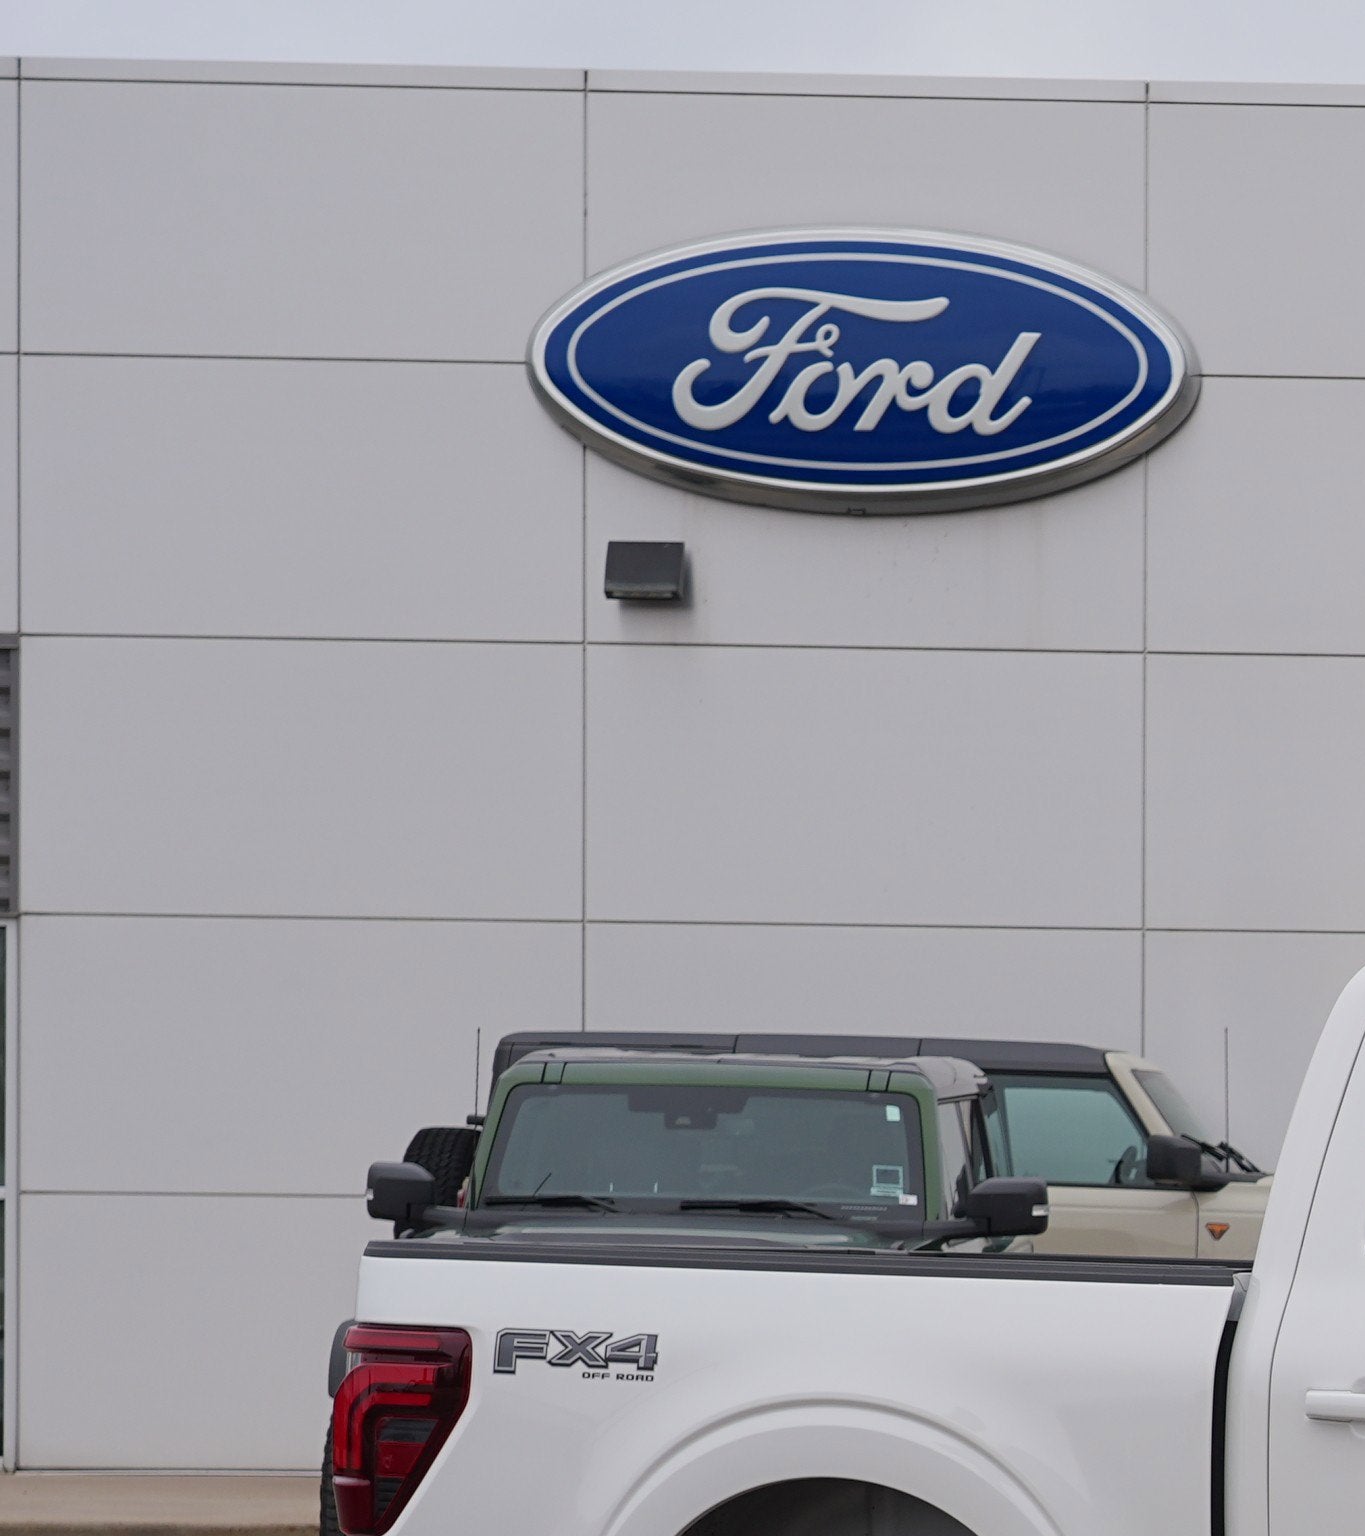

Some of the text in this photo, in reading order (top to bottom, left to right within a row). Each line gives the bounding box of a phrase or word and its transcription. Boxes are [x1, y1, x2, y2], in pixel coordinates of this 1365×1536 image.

[672, 286, 1042, 437] Ford
[493, 1327, 659, 1374] FX4
[581, 1371, 654, 1382] OFF ROAD
